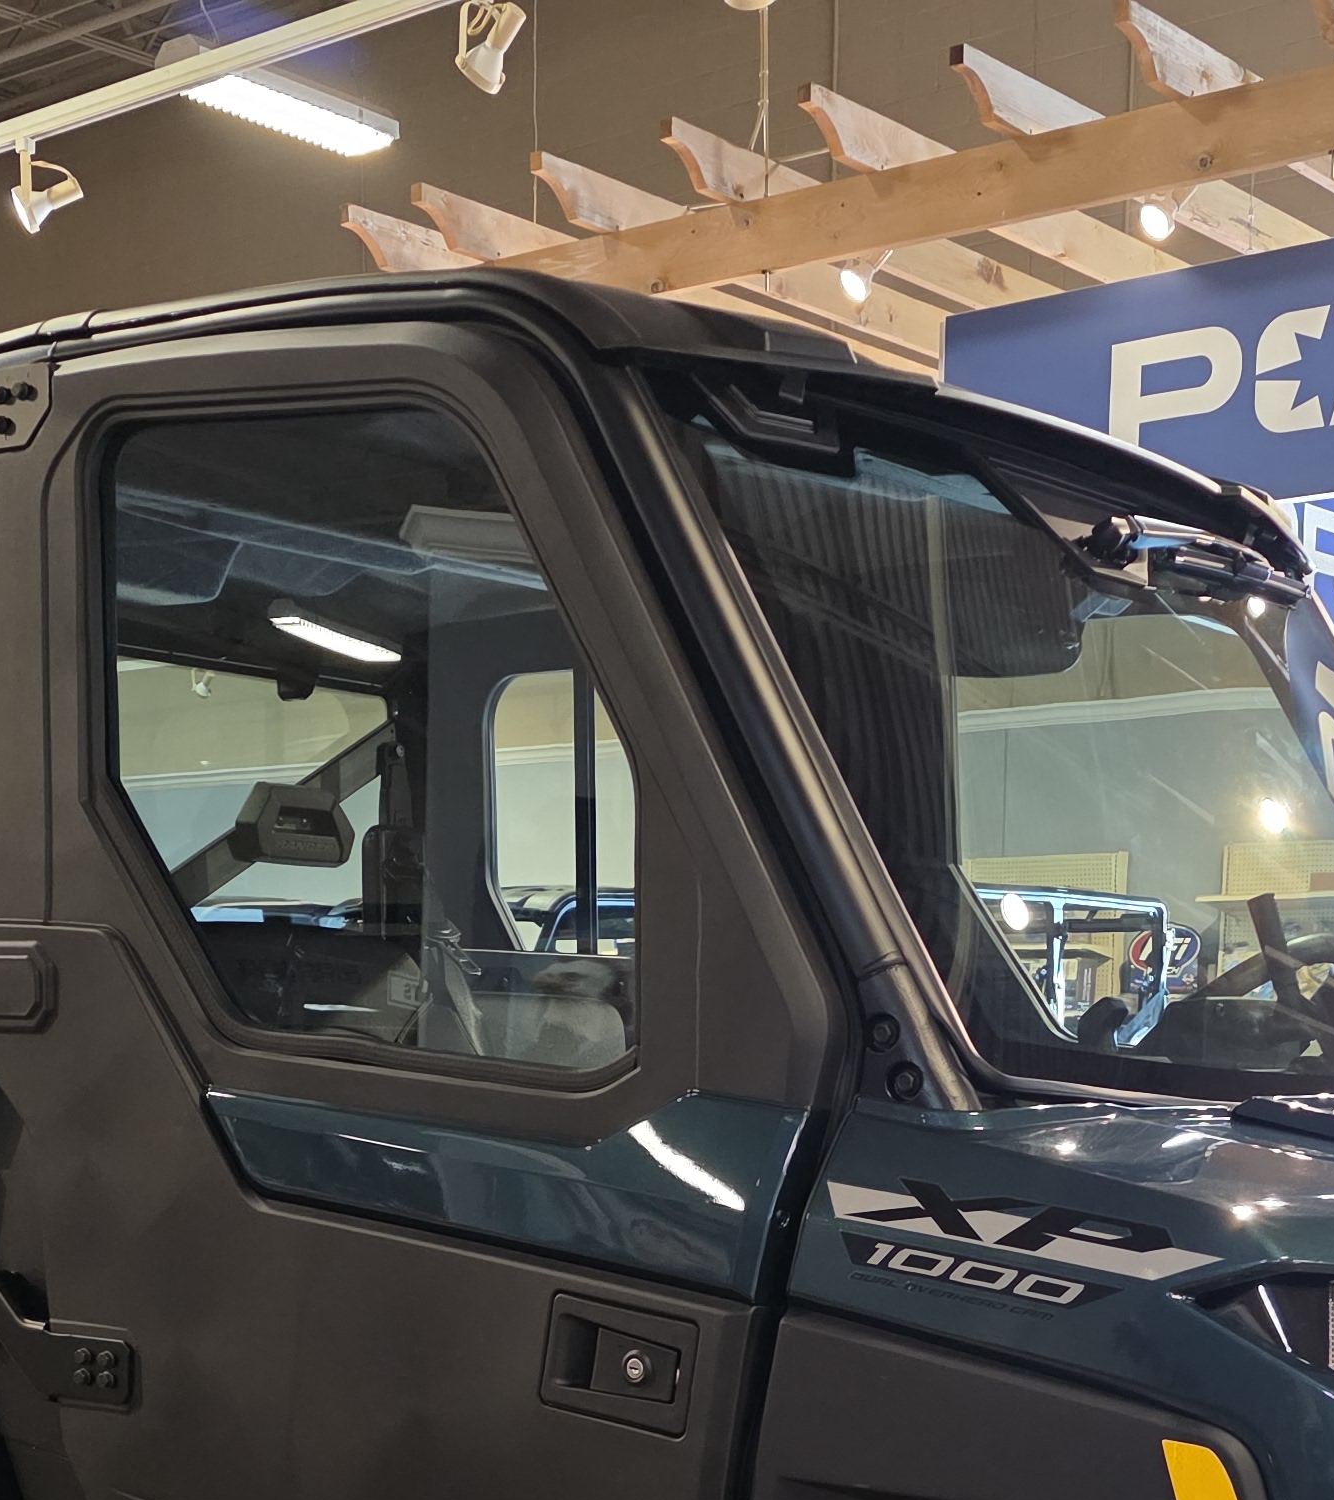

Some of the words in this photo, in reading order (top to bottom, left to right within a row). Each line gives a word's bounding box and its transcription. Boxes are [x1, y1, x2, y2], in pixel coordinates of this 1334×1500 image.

[844, 1178, 1175, 1253] XP
[849, 1271, 898, 1289] DUAL
[903, 1281, 1007, 1311] OVERHEAD
[1009, 1305, 1055, 1322] CAM
[866, 1242, 1085, 1304] 1000
